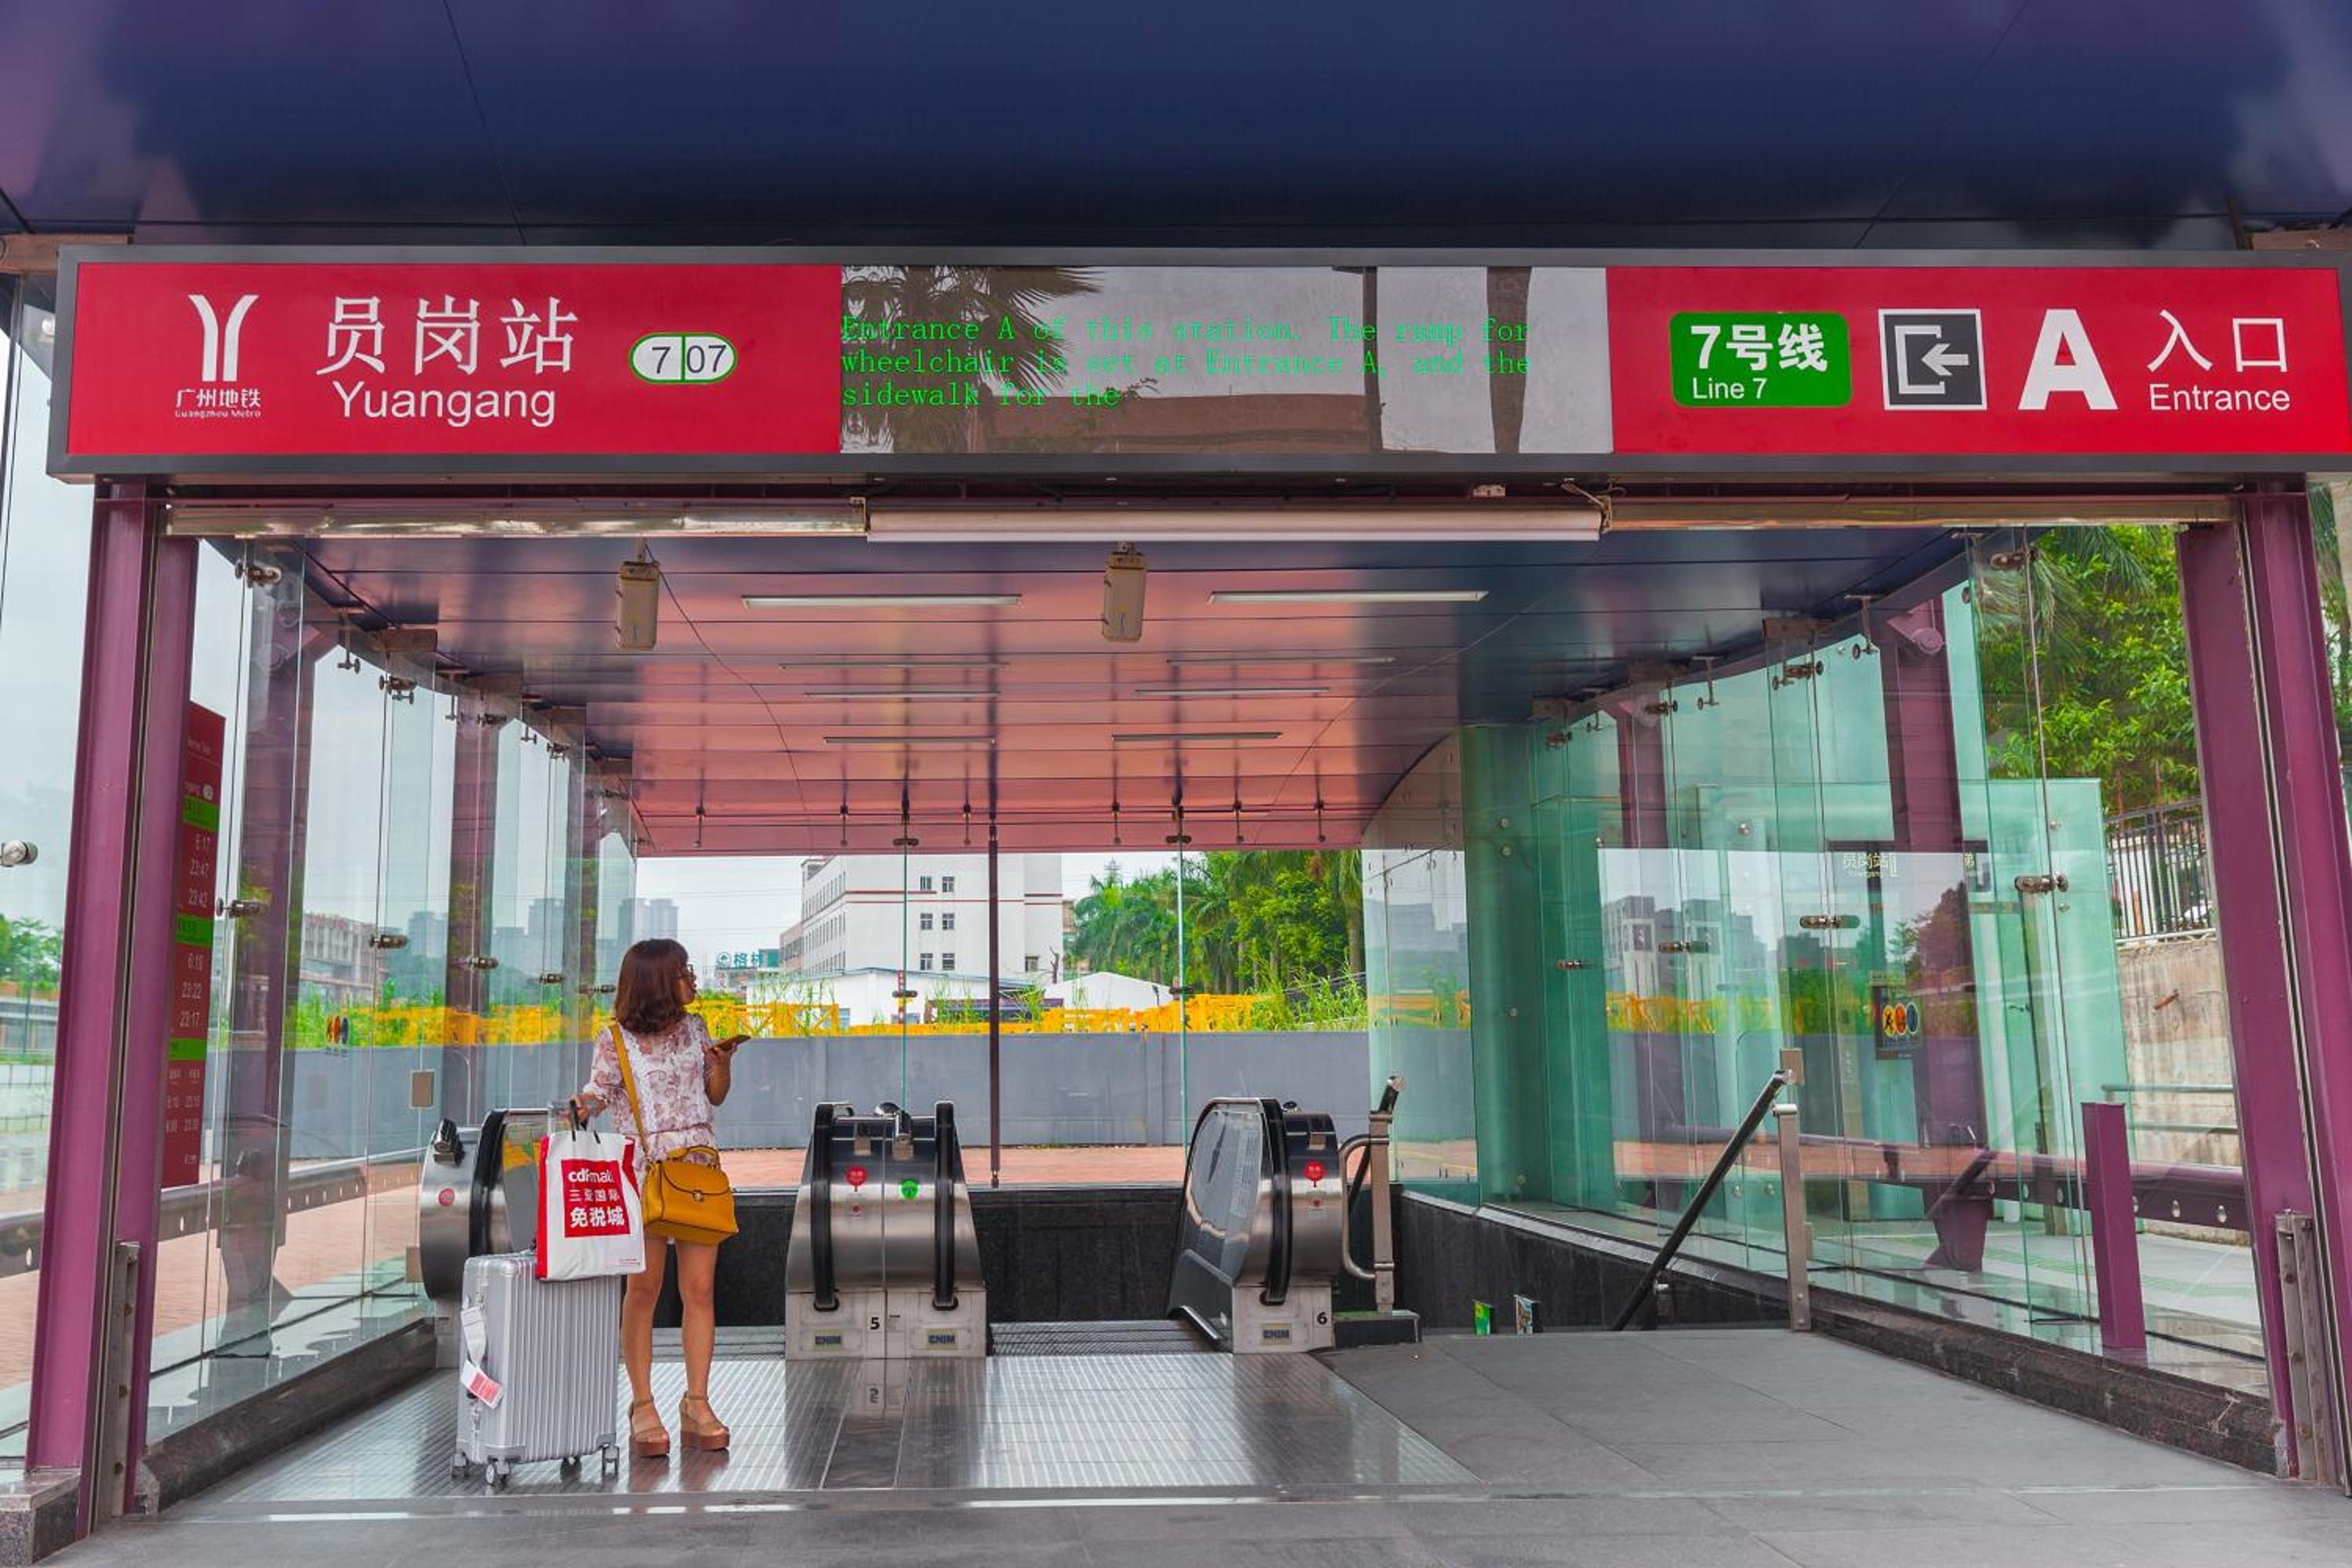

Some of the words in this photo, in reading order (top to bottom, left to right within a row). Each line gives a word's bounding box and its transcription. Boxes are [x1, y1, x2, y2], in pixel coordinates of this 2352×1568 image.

[315, 294, 579, 377] 员岗站
[841, 315, 979, 341] Entrance
[996, 315, 1016, 340] A
[1033, 315, 1067, 340] of
[1085, 315, 1152, 340] this
[1328, 316, 1377, 341] The
[1481, 316, 1532, 341] for
[1689, 323, 1829, 372] 7号线
[2146, 308, 2289, 374] 入口
[841, 350, 1015, 375] wheelchair
[1036, 350, 1068, 375] is
[1087, 350, 1131, 375] set
[1153, 350, 1192, 375] at
[1206, 350, 1344, 375] Entrance
[1412, 350, 1464, 375] and
[1481, 350, 1532, 375] the
[2017, 309, 2118, 410] A
[175, 388, 262, 408] 广州地铁
[841, 382, 979, 406] sidewalk
[1001, 382, 1046, 406] for
[1071, 382, 1121, 406] the
[1692, 377, 1745, 401] Line
[1751, 378, 1768, 400] 7
[2149, 384, 2292, 412] Entrance
[331, 380, 556, 428] Yuangang
[570, 1206, 626, 1229] 免税城
[869, 1316, 880, 1330] 5
[1316, 1312, 1327, 1325] 6
